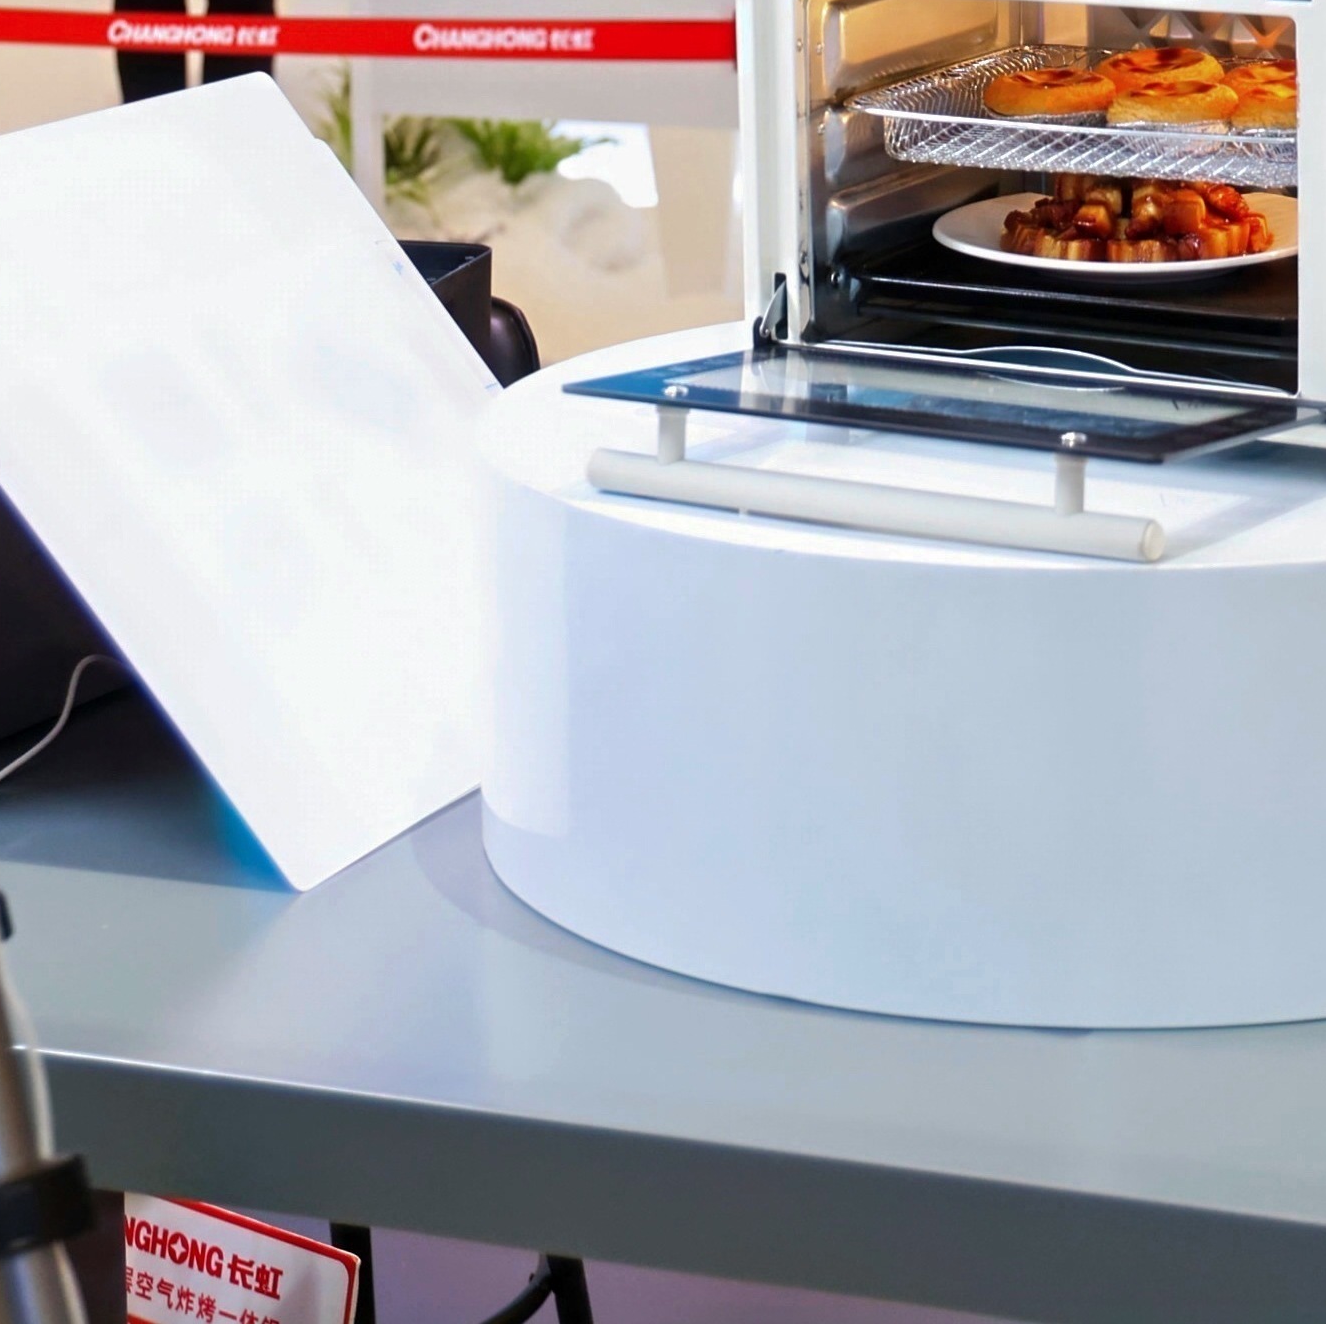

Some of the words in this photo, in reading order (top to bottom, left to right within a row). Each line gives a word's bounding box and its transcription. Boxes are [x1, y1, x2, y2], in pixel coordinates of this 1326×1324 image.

[107, 18, 235, 45] CHANGHONG
[412, 23, 548, 50] CHANGHONG
[227, 1253, 284, 1301] 长虹
